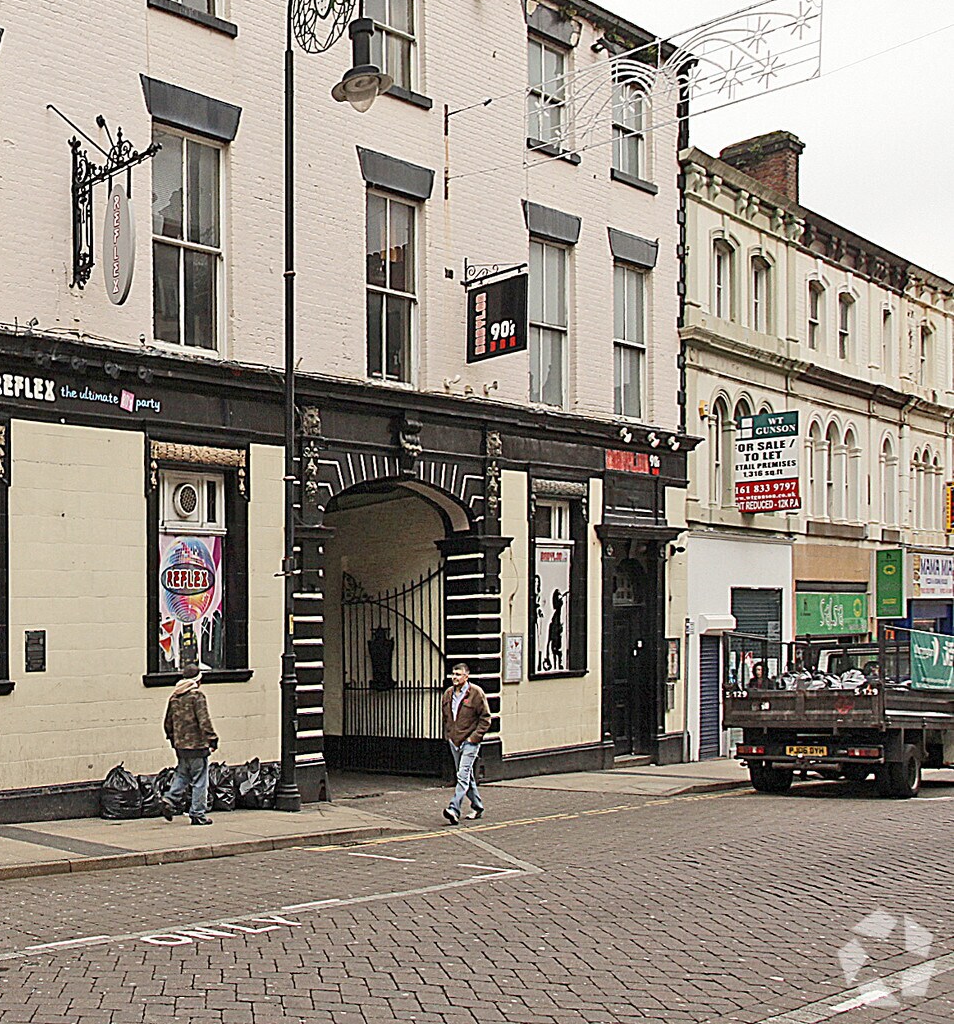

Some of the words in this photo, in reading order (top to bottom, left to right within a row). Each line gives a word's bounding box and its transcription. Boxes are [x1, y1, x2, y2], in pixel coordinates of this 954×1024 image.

[112, 195, 120, 294] REFLEX
[490, 319, 516, 341] 90's
[60, 385, 77, 398] the
[79, 386, 119, 404] ultimate
[135, 398, 161, 412] party
[767, 417, 784, 425] WT
[755, 424, 797, 435] GUNSON
[757, 440, 786, 451] SALE
[744, 453, 759, 462] TO
[762, 450, 783, 460] LET
[735, 463, 756, 471] ETAIL
[757, 460, 796, 469] PREMISES
[735, 485, 751, 495] 161
[753, 483, 771, 493] 833
[773, 481, 797, 491] 9797
[746, 500, 774, 510] REDUCED
[920, 558, 940, 575] MAMA
[166, 569, 209, 589] REFLEX
[732, 690, 748, 698] 129
[862, 687, 879, 696] 129
[140, 915, 302, 946] ONLY
